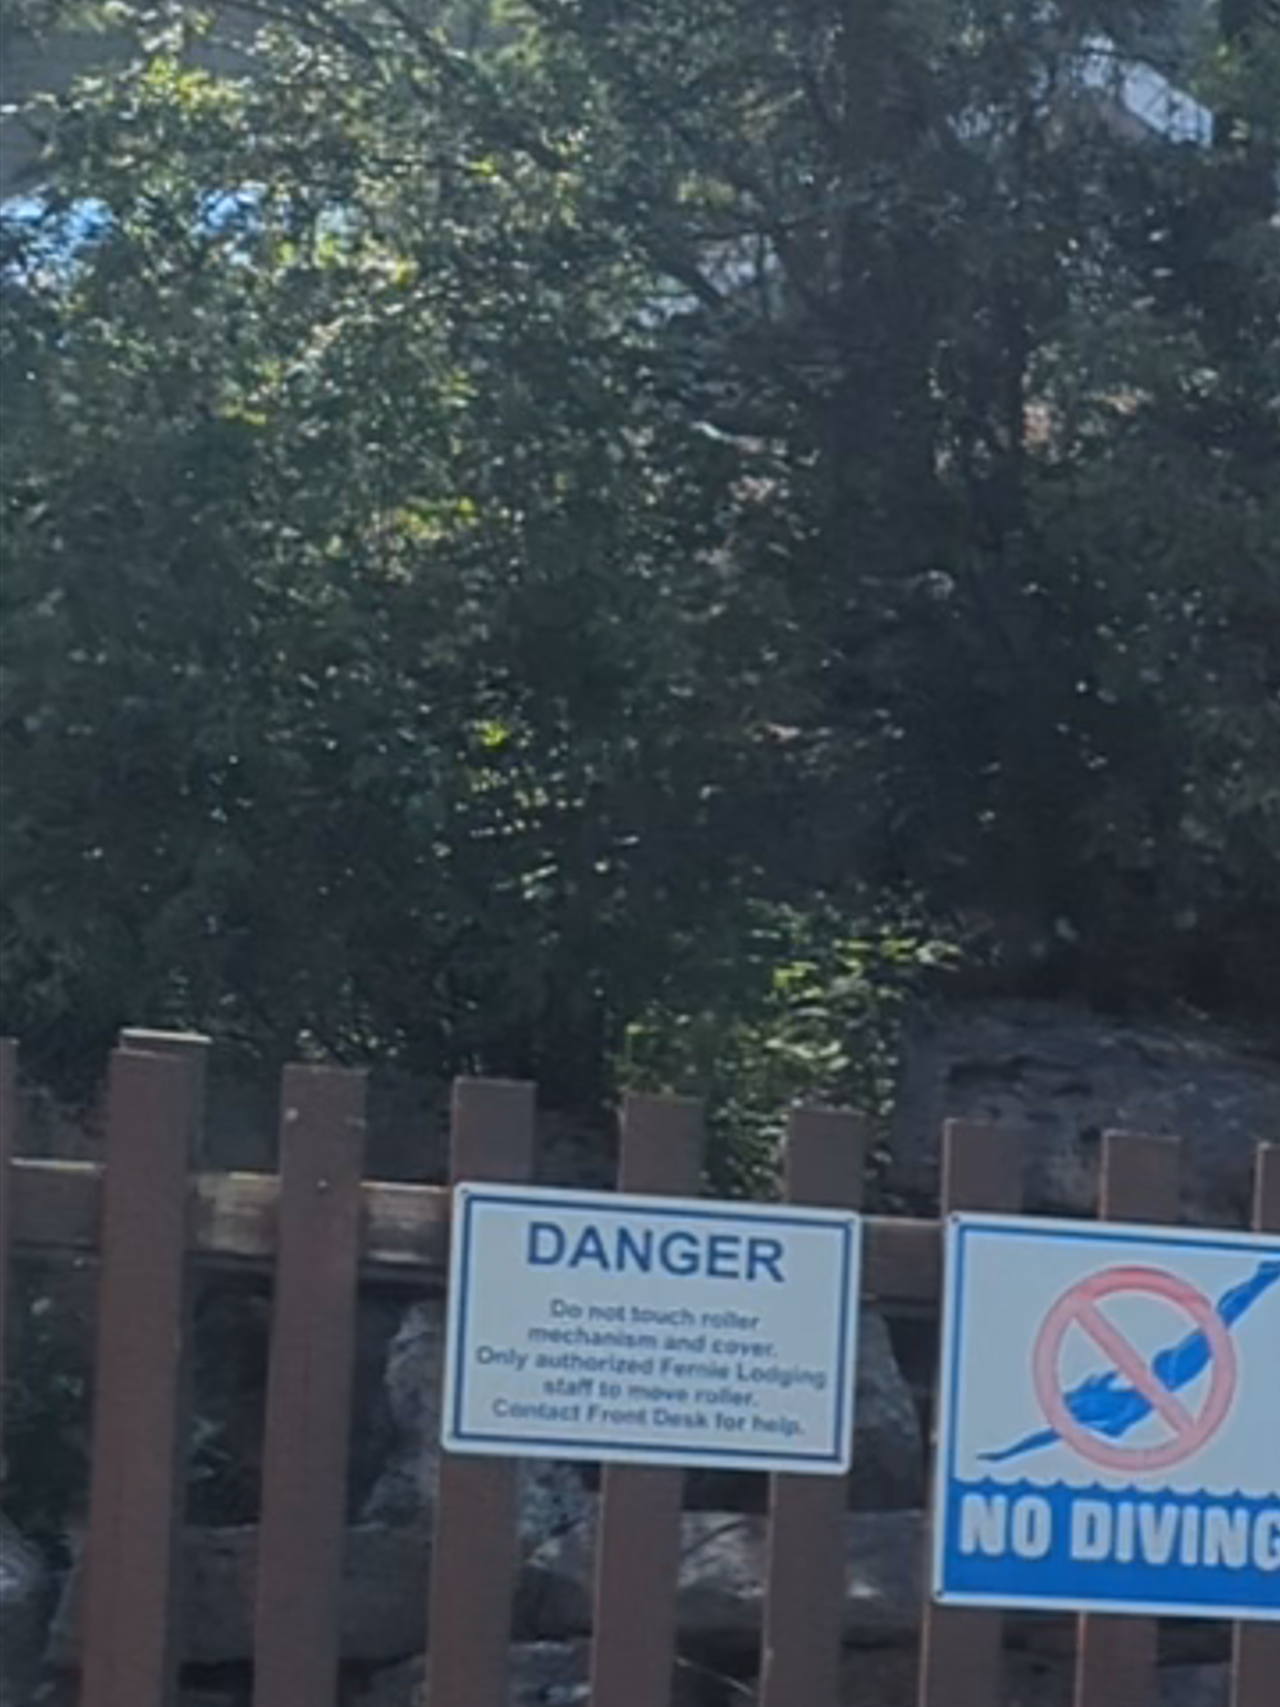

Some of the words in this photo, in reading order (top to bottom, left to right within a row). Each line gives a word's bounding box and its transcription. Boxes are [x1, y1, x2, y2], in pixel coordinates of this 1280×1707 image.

[527, 1221, 786, 1283] DANGER
[550, 1298, 582, 1320] Do
[588, 1304, 625, 1322] not
[631, 1305, 695, 1328] touch
[701, 1311, 760, 1332] roller
[527, 1327, 657, 1350] mechanism
[664, 1334, 706, 1353] and
[712, 1340, 778, 1359] cover.
[475, 1346, 530, 1372] Only
[535, 1353, 654, 1376] authorized
[660, 1358, 729, 1380] Fernie
[736, 1362, 828, 1390] Lodging
[543, 1376, 594, 1397] staff
[599, 1381, 622, 1398] to
[628, 1386, 688, 1403] move
[492, 1399, 582, 1423] Contact
[586, 1404, 648, 1425] Front
[653, 1409, 712, 1430] Desk
[715, 1411, 747, 1431] for
[958, 1493, 1053, 1560] NO
